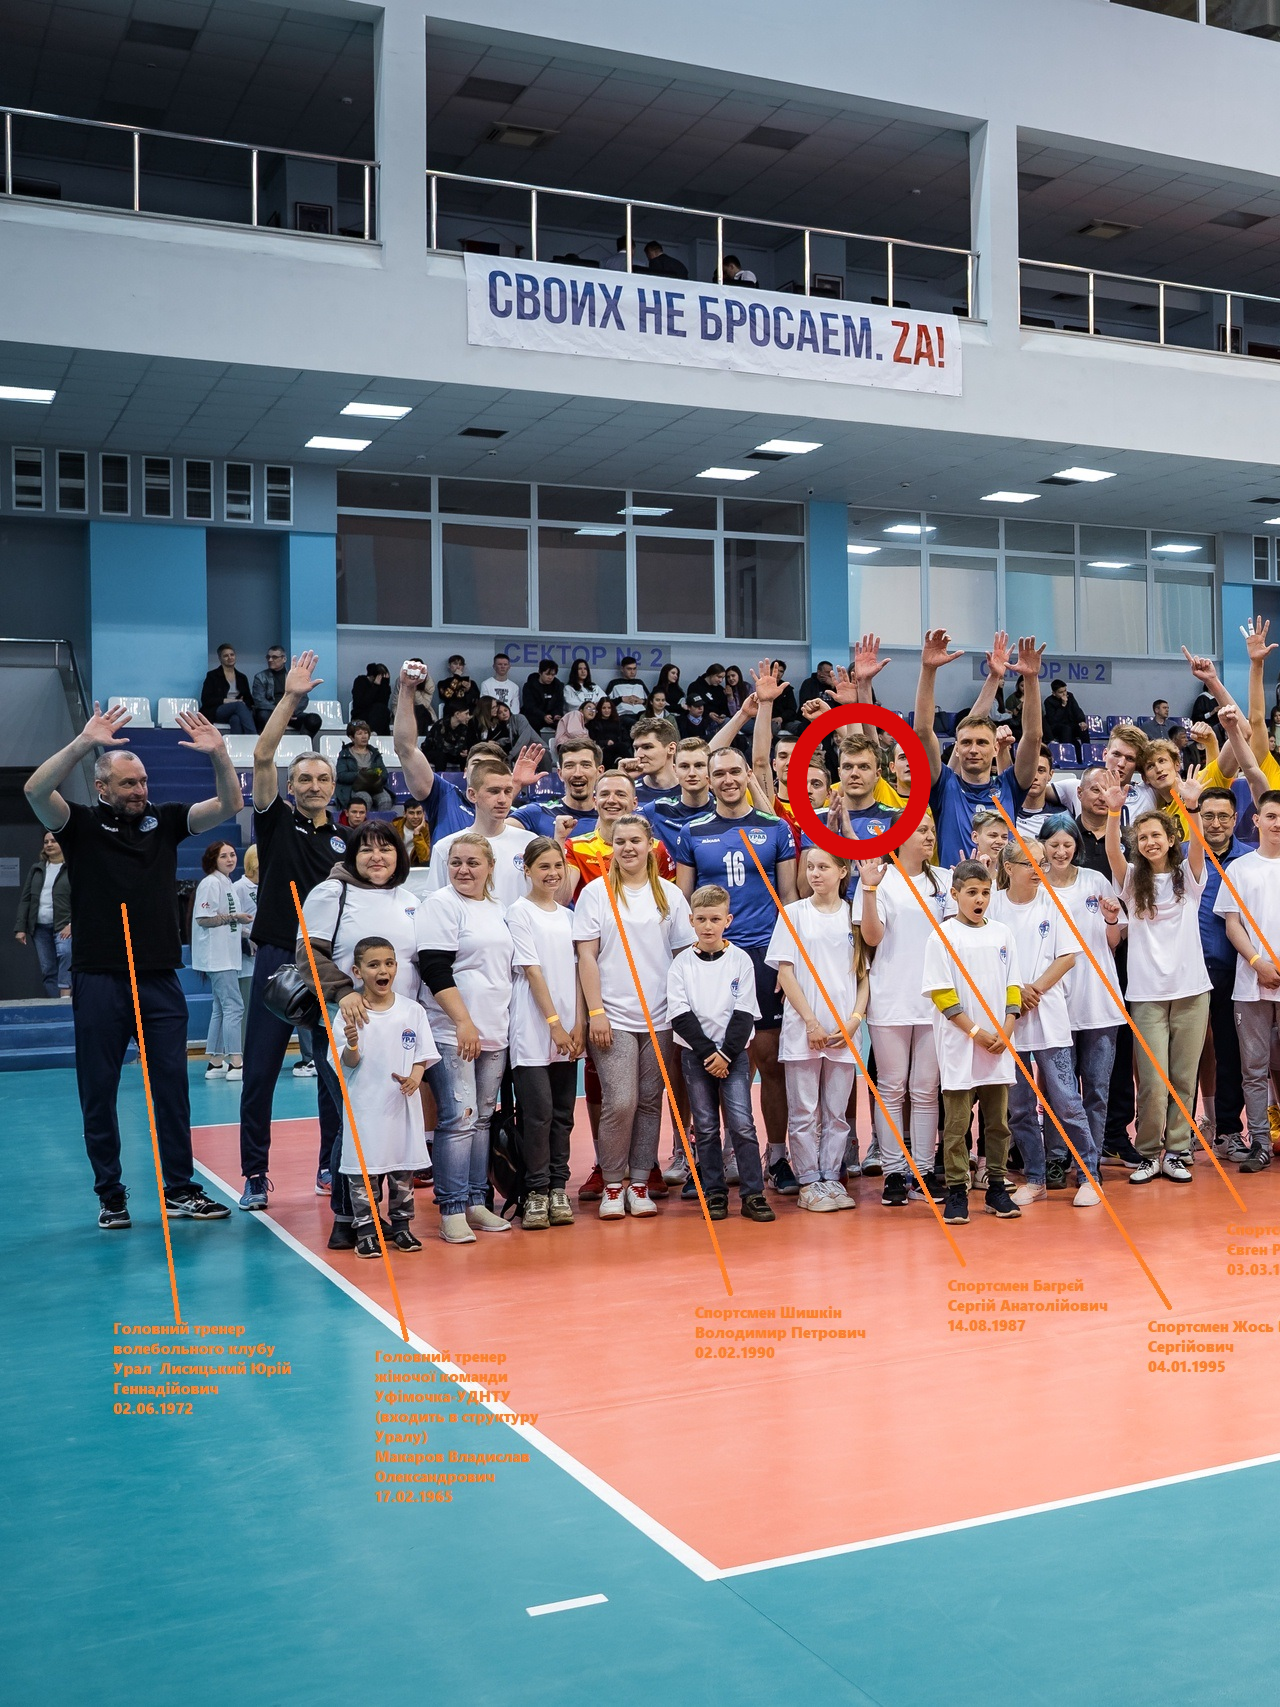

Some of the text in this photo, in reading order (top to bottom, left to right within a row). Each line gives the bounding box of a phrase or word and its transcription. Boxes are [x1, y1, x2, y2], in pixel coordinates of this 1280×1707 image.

[488, 270, 945, 368] СВОИХ НЕ БРОСАЕМ. ZA!
[504, 642, 607, 665] СЕКТОР
[651, 649, 663, 667] 2
[1069, 663, 1088, 679] №
[1095, 664, 1105, 681] 2
[722, 850, 746, 888] 16
